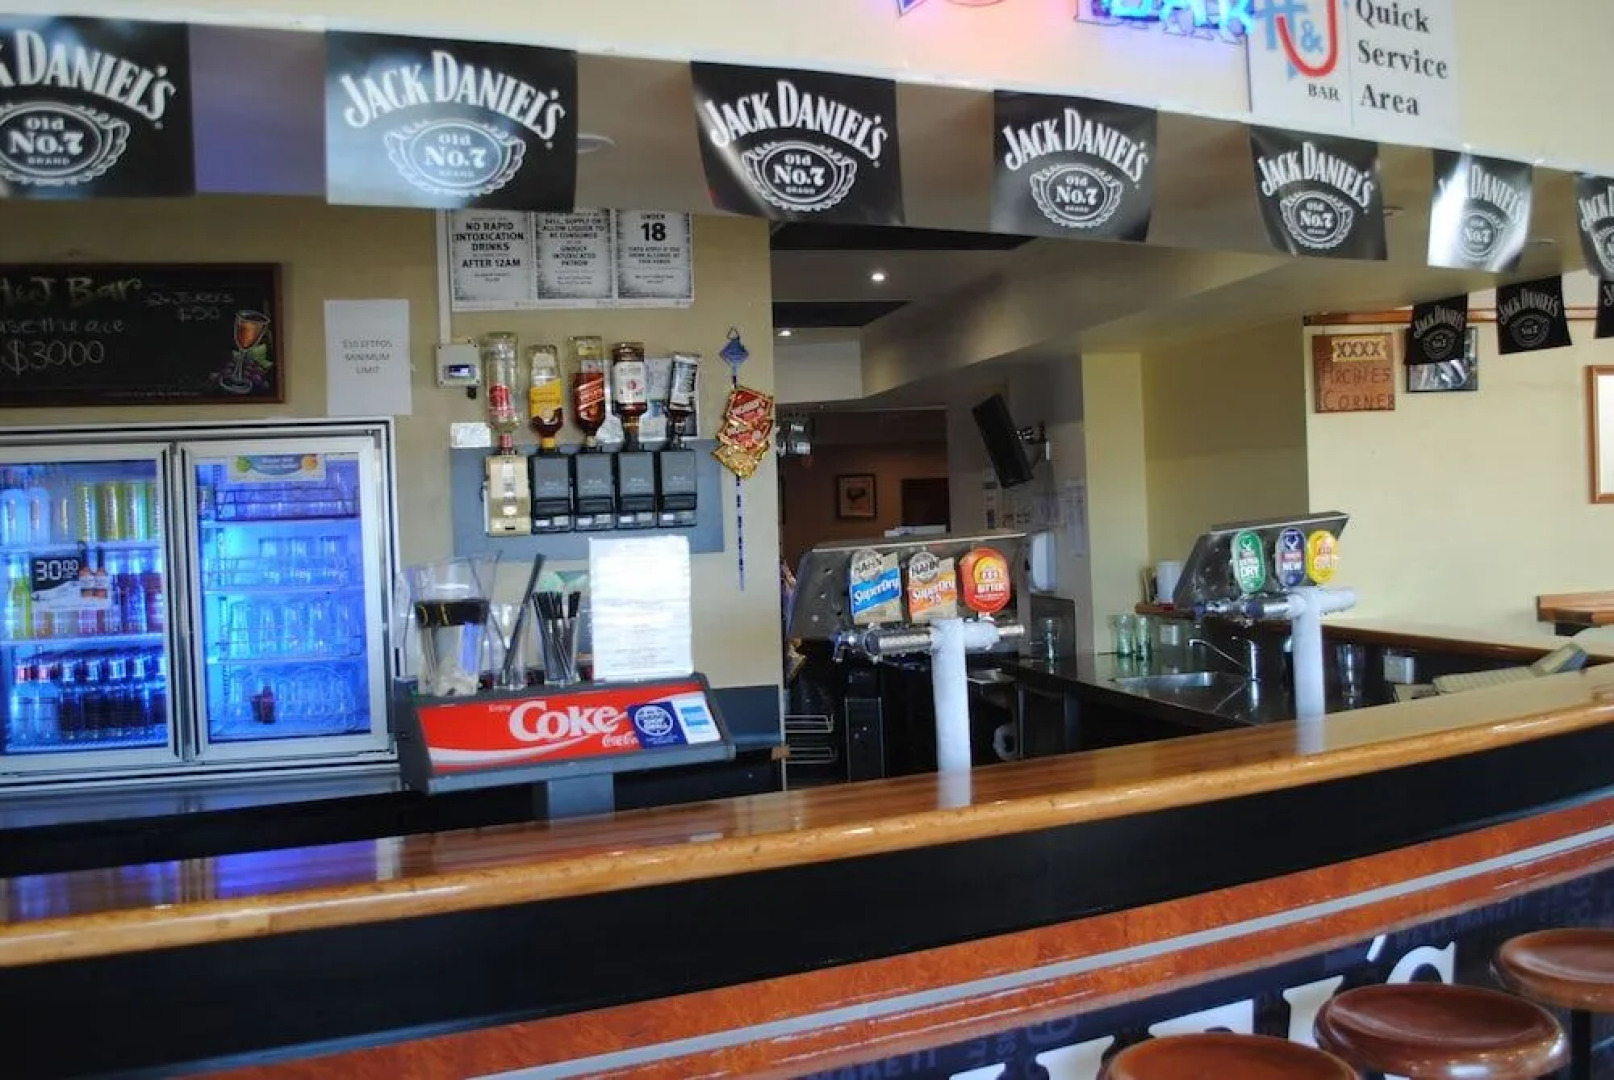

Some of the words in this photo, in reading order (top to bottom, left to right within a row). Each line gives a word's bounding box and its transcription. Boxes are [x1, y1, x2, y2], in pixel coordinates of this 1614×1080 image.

[1356, 0, 1430, 33] Quick
[1358, 40, 1447, 79] Service
[17, 30, 176, 122] DANIEL'S
[340, 64, 425, 128] JACK
[433, 50, 566, 140] DANIEL'S
[1308, 84, 1340, 101] BAR
[1360, 84, 1419, 116] Area
[704, 93, 776, 148] JACK
[777, 80, 888, 161] DANIEL'S
[9, 130, 86, 156] No.7
[1003, 118, 1061, 171] JACK
[1064, 107, 1149, 183] DANIEL'S
[423, 146, 486, 169] No.7
[773, 165, 826, 187] No.7
[1257, 151, 1300, 197] JACK
[1302, 141, 1375, 208] DANIEL'S
[1054, 187, 1098, 206] No.7
[466, 222, 480, 231] NO
[483, 222, 514, 231] RAPID
[641, 222, 666, 242] 18
[1299, 210, 1335, 229] No.7
[456, 232, 524, 241] INTOXICATION
[472, 243, 510, 251] DRINKS
[462, 259, 492, 268] AFTER
[494, 259, 520, 268] 12AM
[65, 275, 143, 306] Bar
[1, 338, 105, 376] $3000
[1336, 341, 1381, 359] XXXX
[509, 701, 626, 742] Coke
